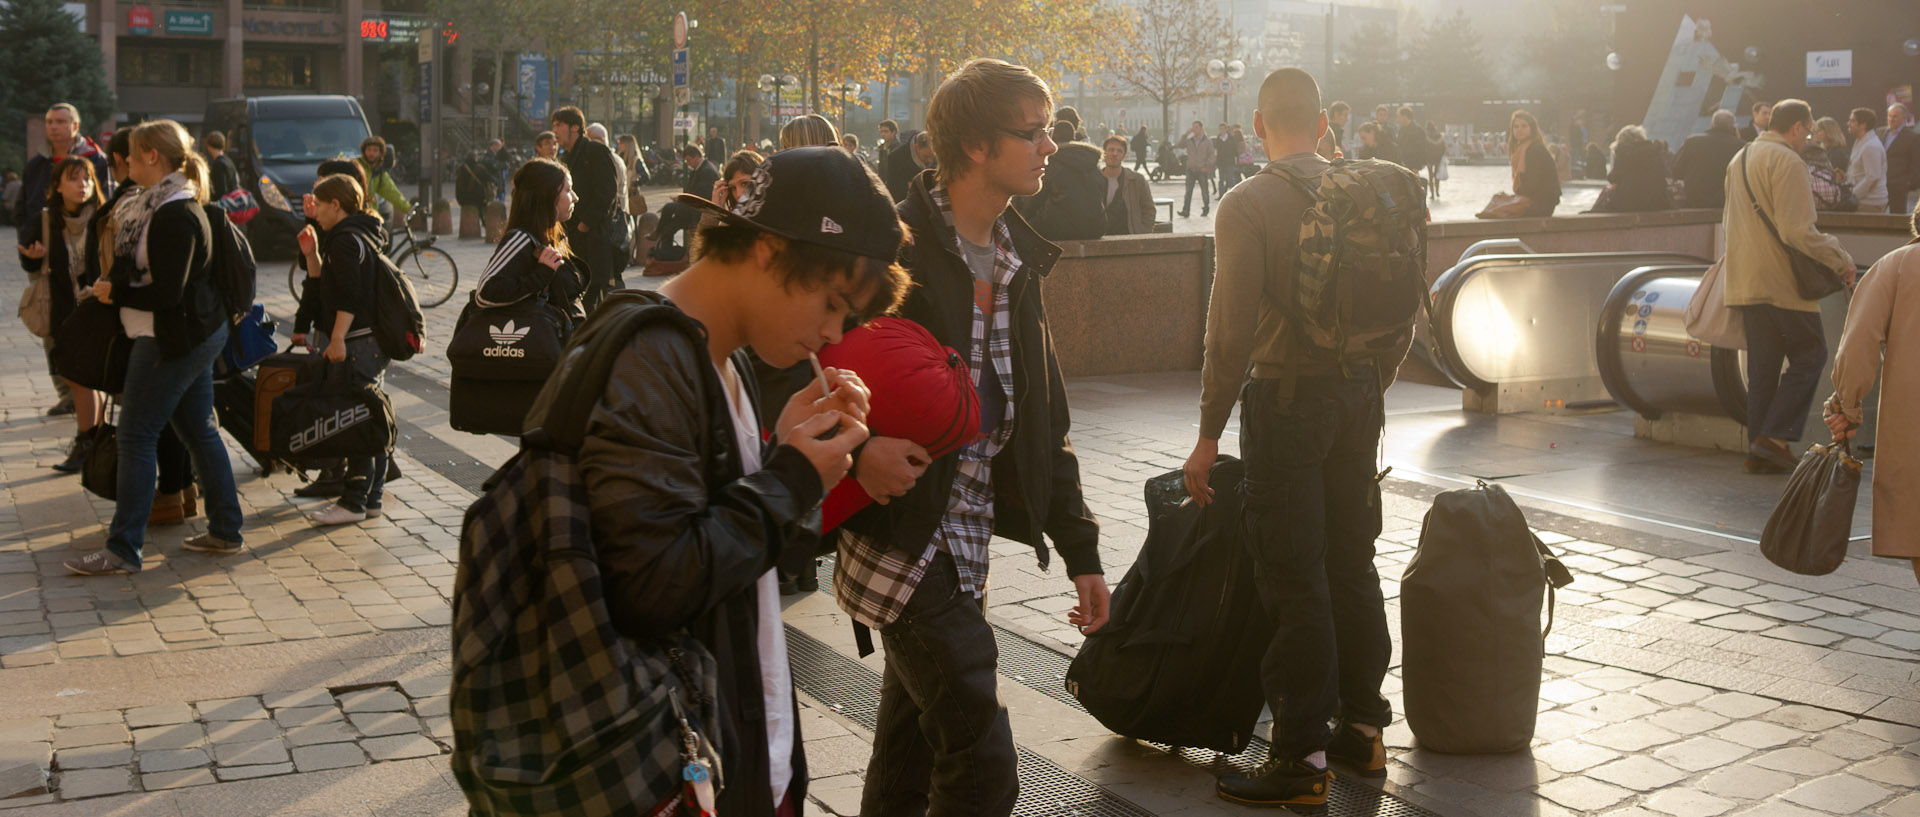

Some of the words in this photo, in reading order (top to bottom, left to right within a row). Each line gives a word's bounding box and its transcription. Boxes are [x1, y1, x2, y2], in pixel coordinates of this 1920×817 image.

[241, 16, 330, 36] NOVOTEL
[483, 345, 525, 358] adidas
[289, 403, 371, 453] adidas
